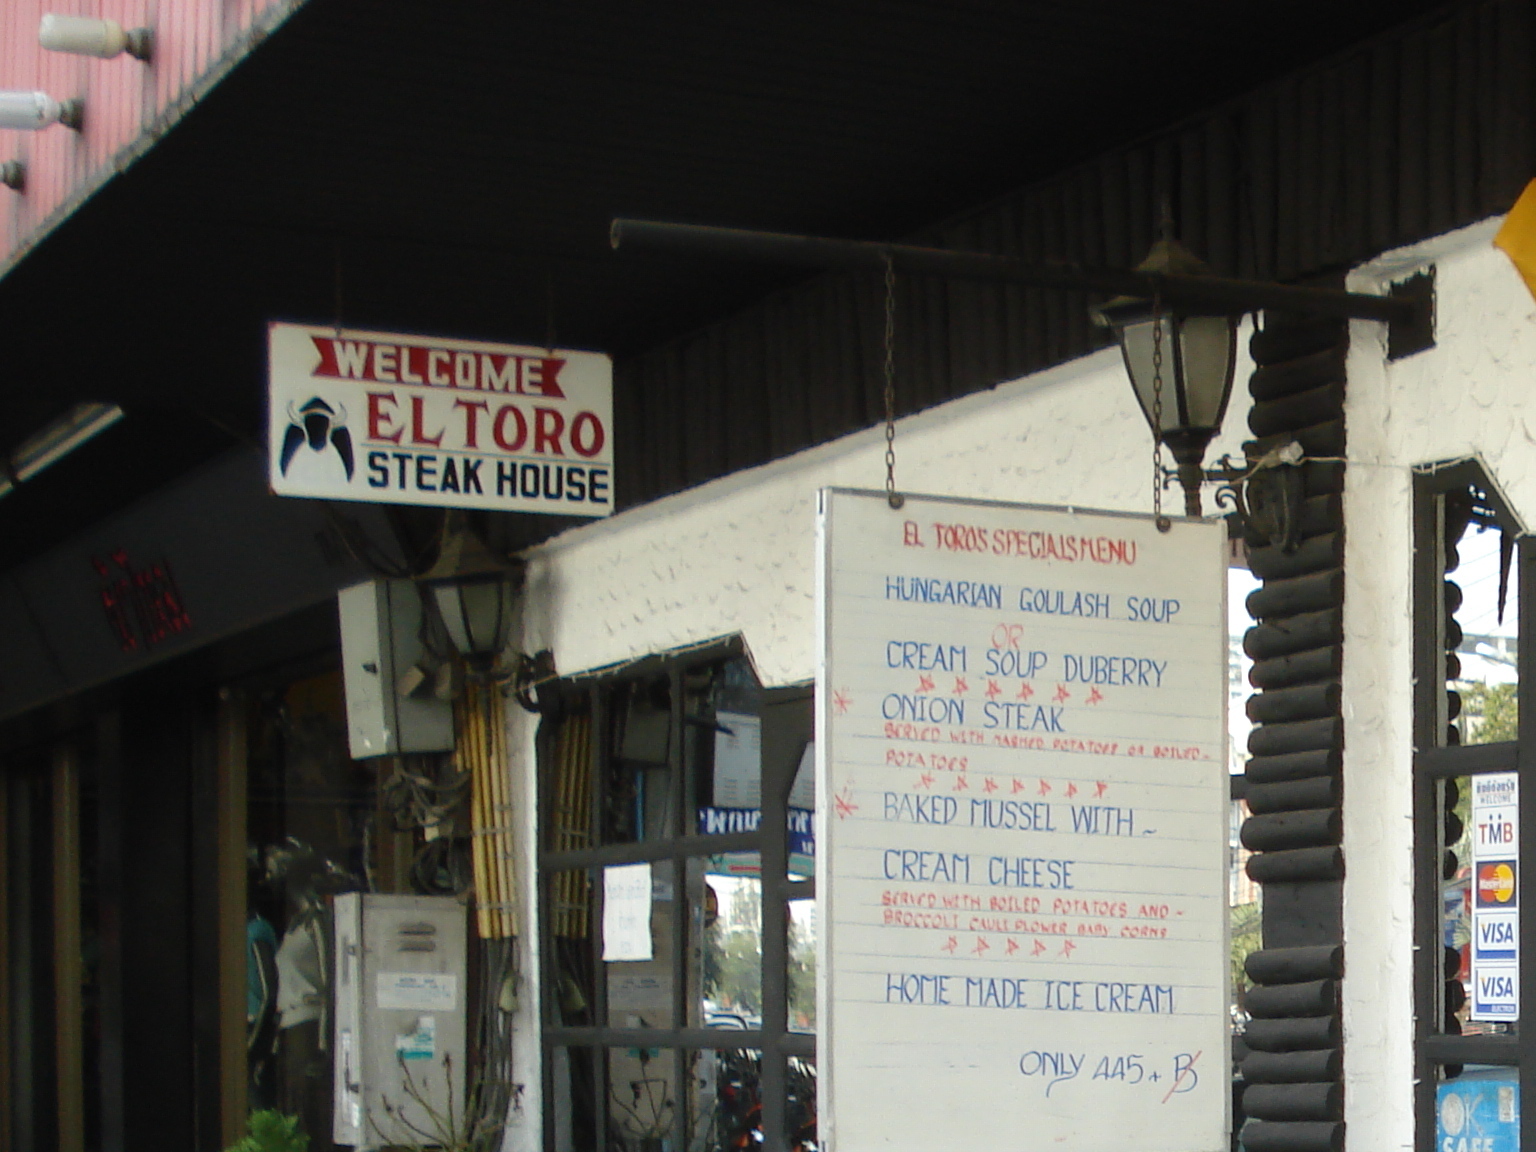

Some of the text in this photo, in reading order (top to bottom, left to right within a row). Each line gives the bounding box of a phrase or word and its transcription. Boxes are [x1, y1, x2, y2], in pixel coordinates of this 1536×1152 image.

[332, 340, 544, 396] WELCOME
[366, 390, 606, 458] EL TORO
[367, 451, 610, 505] STEAK HOUSE
[903, 520, 924, 548] EL
[886, 575, 1181, 623] HUNGARIAN GOULASH SOUP
[991, 623, 1024, 651] OR
[886, 640, 1168, 688] CREAM SOUP DUBERRY
[881, 692, 1067, 733] ONION STEAK
[883, 791, 1135, 836] BAKED MUSSEL WITH
[1478, 818, 1513, 844] TMB
[883, 848, 1076, 890] CREAM CHEESE
[882, 908, 960, 930] BROCCOLI
[989, 896, 1041, 915] BOILED
[1053, 898, 1128, 917] POTATOES
[1138, 903, 1170, 918] AND
[1480, 922, 1514, 944] VISA
[886, 973, 1175, 1015] HOME MADE ICE CREAM
[1480, 976, 1514, 998] VISA
[1019, 1050, 1086, 1099] ONLY
